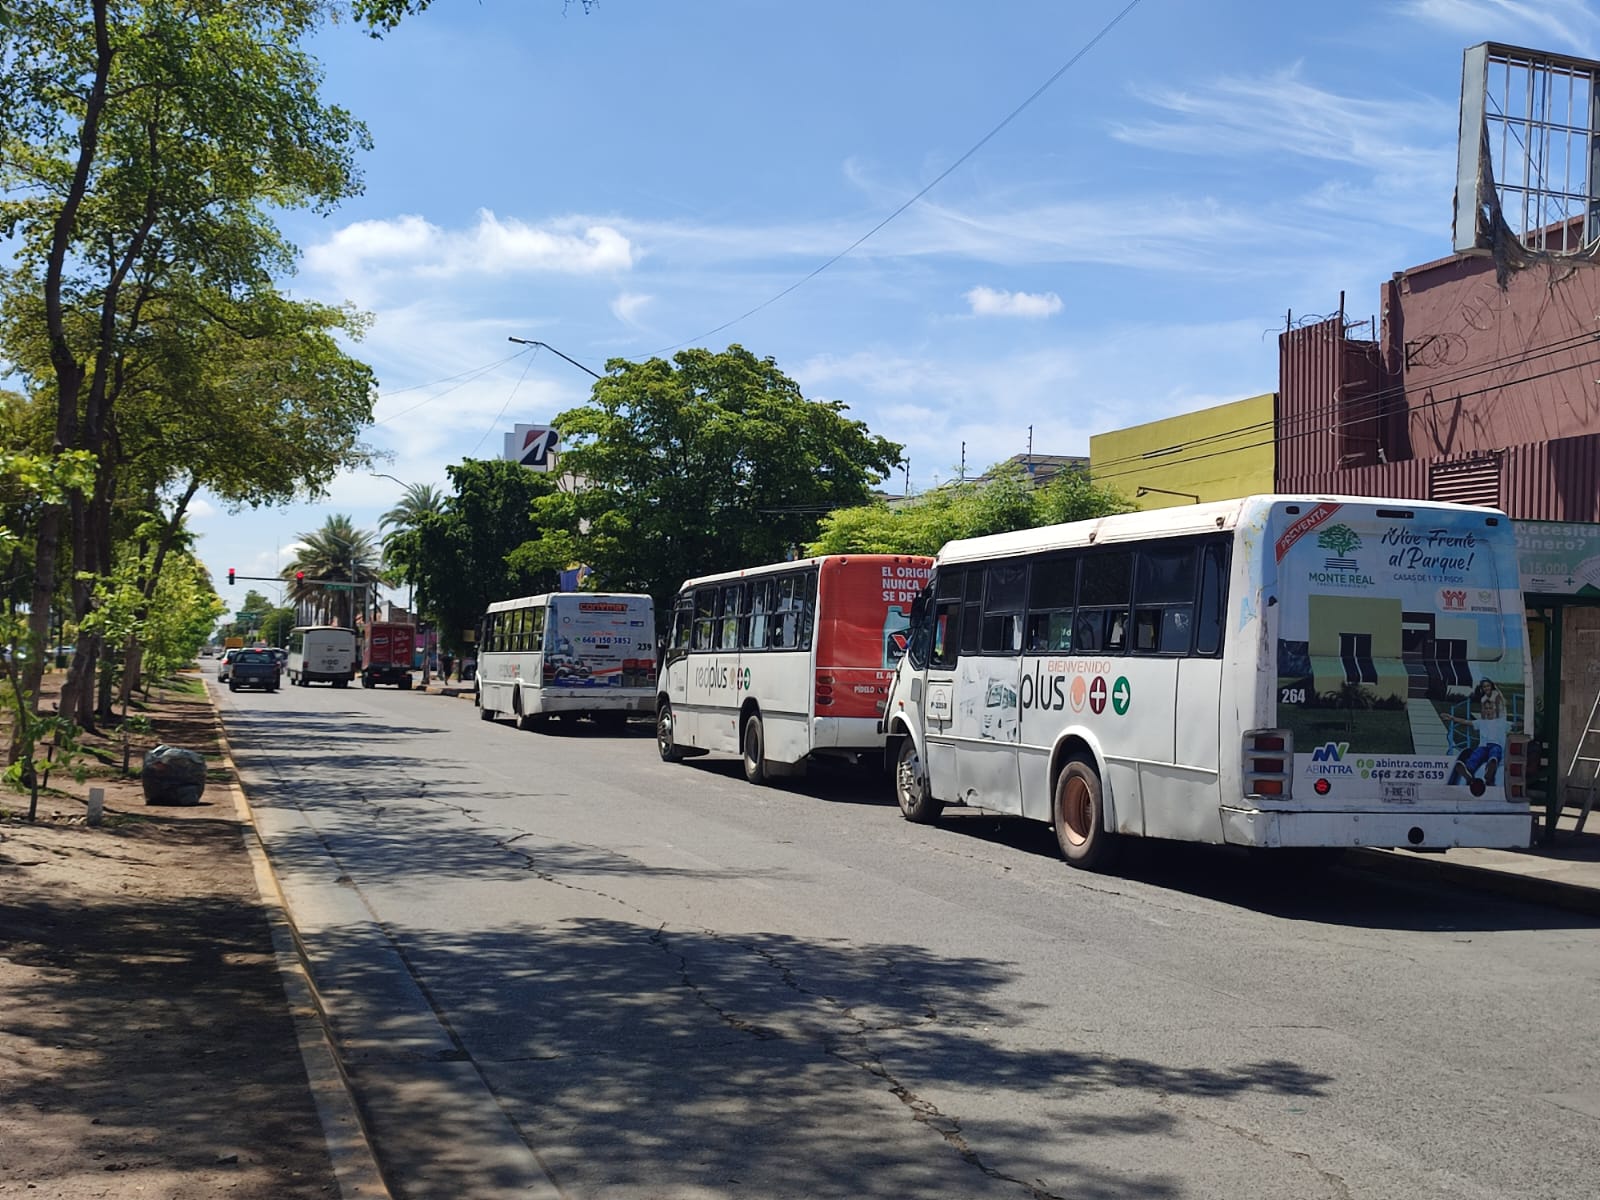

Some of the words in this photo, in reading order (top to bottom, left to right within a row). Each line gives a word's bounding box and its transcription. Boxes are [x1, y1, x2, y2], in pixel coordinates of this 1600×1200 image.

[1281, 508, 1328, 549] PREVENTA
[1425, 529, 1476, 549] Frente
[1389, 548, 1405, 567] al
[1406, 546, 1475, 574] Parque!
[881, 567, 893, 577] EL
[1393, 573, 1416, 581] CASAS
[882, 578, 919, 590] NUNCA
[1308, 572, 1346, 584] MONTE
[1349, 575, 1375, 585] REAL
[882, 590, 895, 602] SE
[637, 643, 652, 651] 239
[1047, 660, 1111, 674] BIENVENIDO
[1019, 660, 1066, 722] plus
[1281, 688, 1306, 704] 264
[1306, 765, 1353, 774] ABINTRA
[1376, 758, 1449, 769] abintra.com.mx
[1394, 770, 1414, 779] 226
